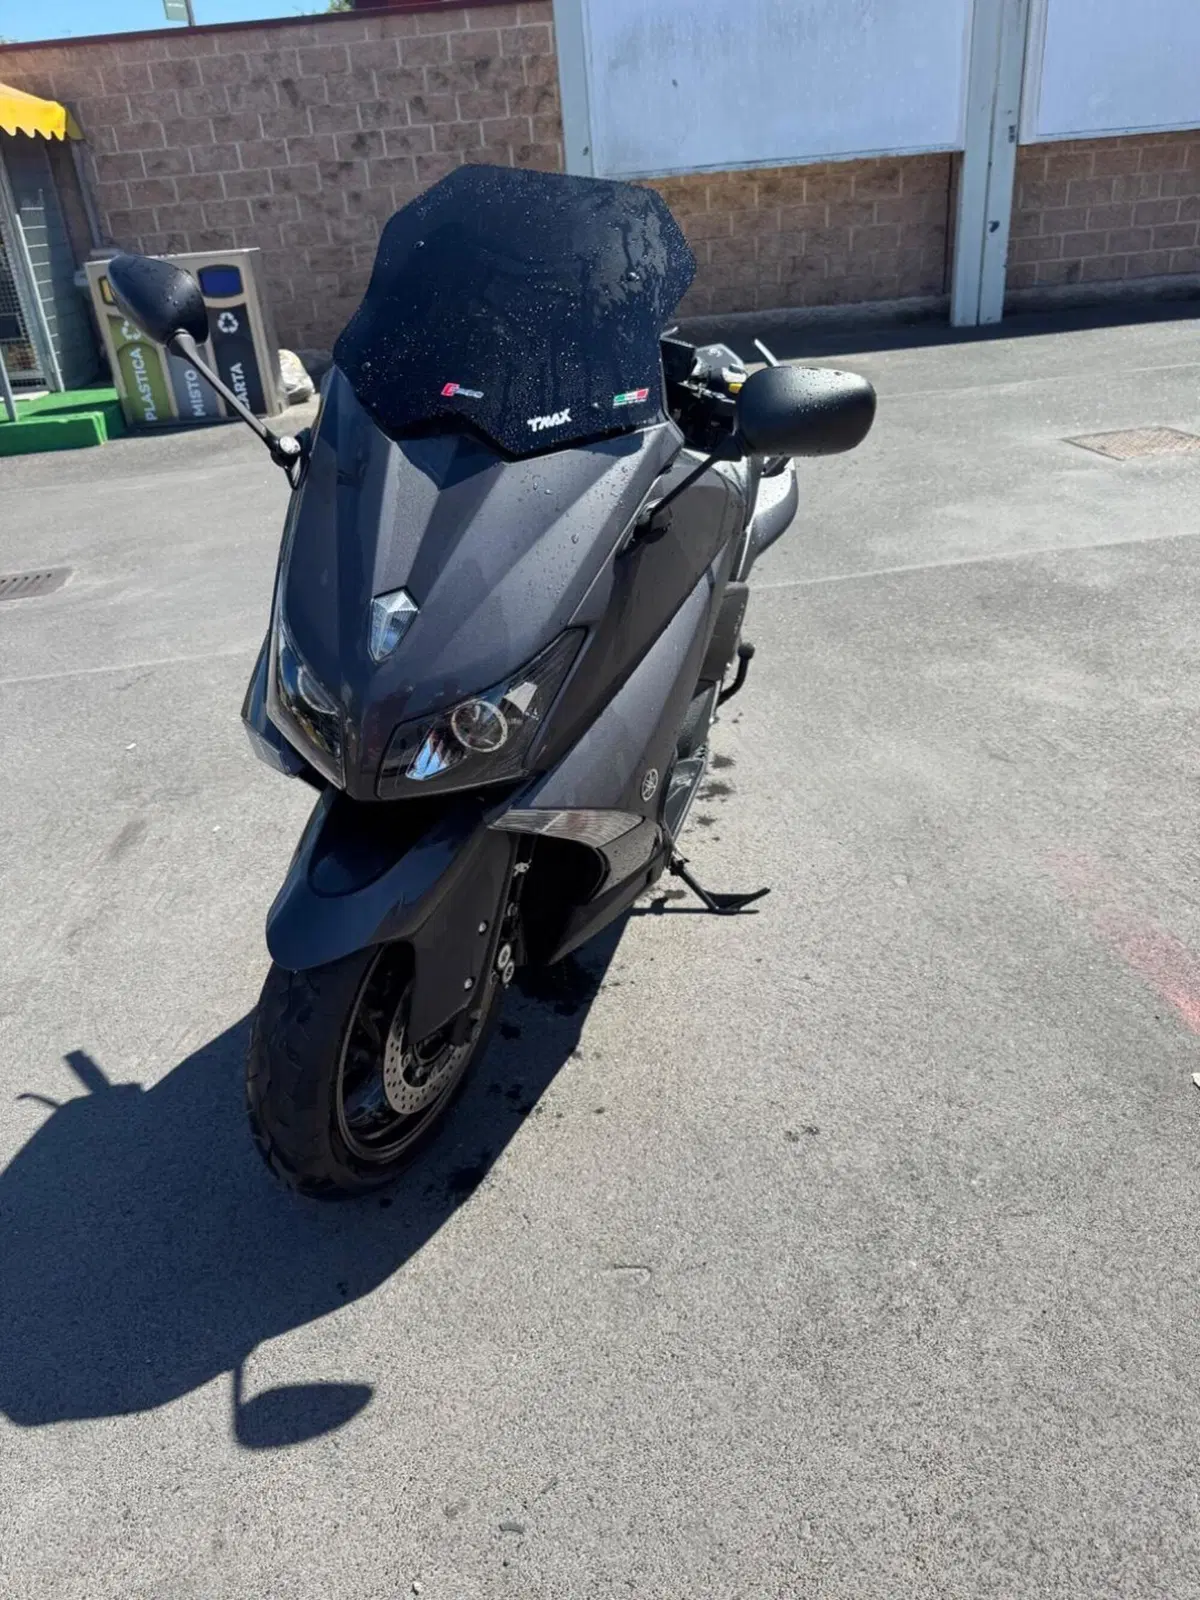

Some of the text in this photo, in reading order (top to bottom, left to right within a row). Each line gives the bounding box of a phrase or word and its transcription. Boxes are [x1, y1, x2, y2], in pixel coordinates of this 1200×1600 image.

[130, 347, 157, 421] PLASTICA
[184, 369, 206, 417] MISTO
[527, 408, 572, 432] TMAX
